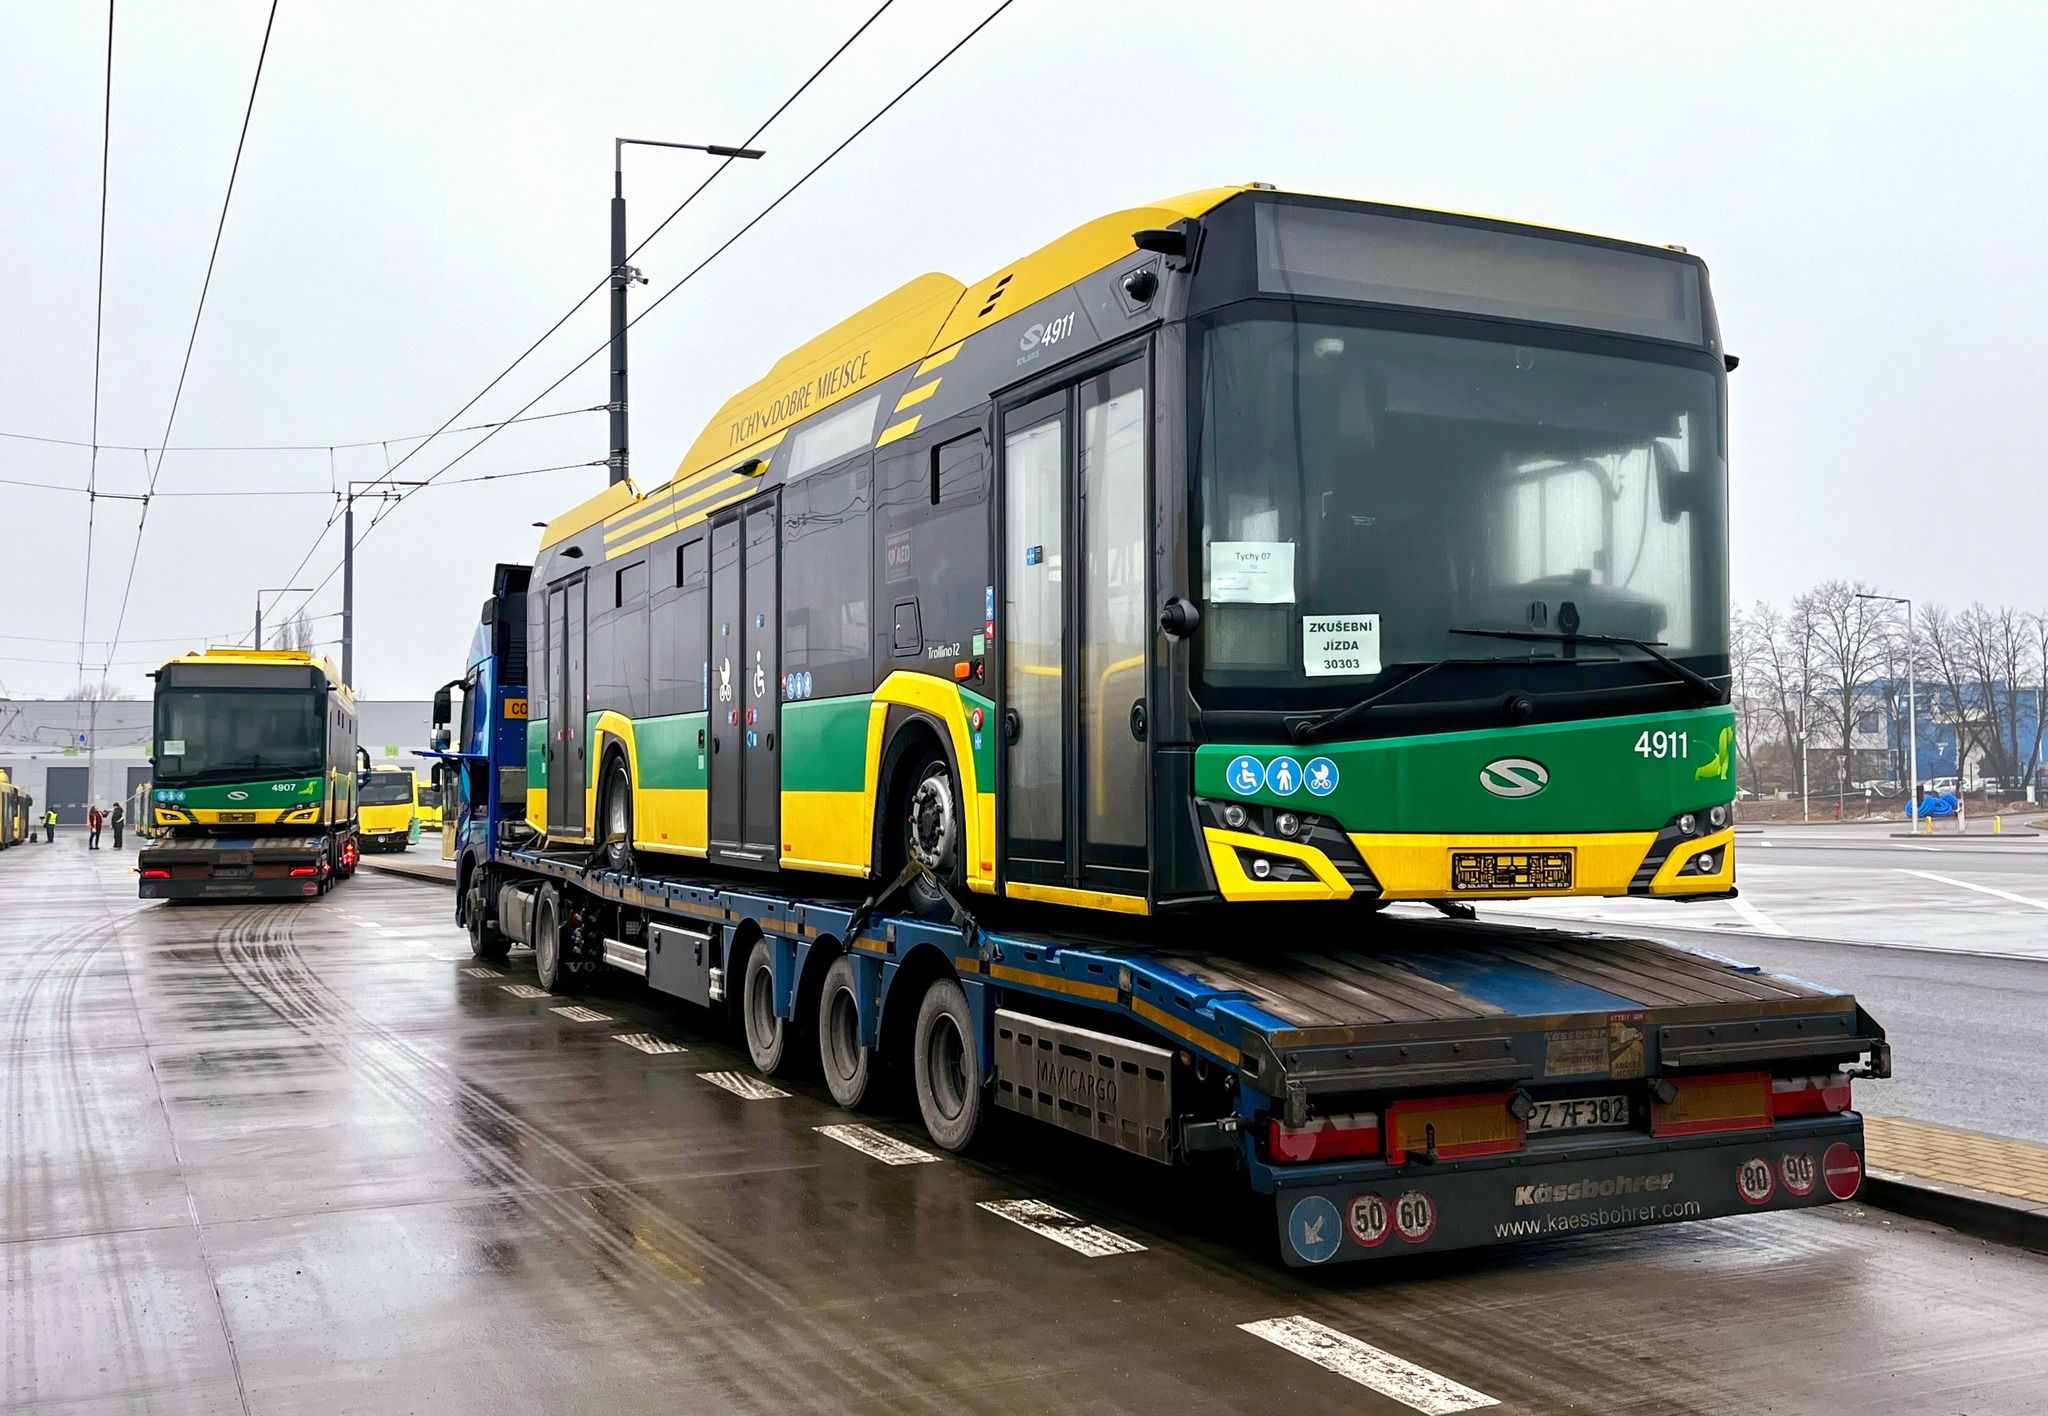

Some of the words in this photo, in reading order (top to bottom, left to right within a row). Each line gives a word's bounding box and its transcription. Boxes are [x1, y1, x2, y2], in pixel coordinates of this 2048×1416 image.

[1041, 311, 1075, 347] 4911
[730, 409, 763, 447] TYCHY
[771, 381, 814, 425] DOBRE
[816, 350, 871, 402] MIEJSCE
[1235, 552, 1259, 561] Tychy
[1261, 552, 1271, 560] 07
[1309, 620, 1372, 633] ZKUŠEBNÍ
[1323, 640, 1359, 651] JÍZDA
[1324, 659, 1360, 669] 30303
[1634, 730, 1687, 758] 4911
[271, 783, 296, 792] 4907
[1037, 1060, 1117, 1103] MAXICARGO
[1744, 1166, 1767, 1191] 80
[1786, 1156, 1810, 1182] 90
[1514, 1173, 1674, 1206] Kässbohrer
[1355, 1201, 1383, 1233] 50
[1401, 1200, 1427, 1229] 60
[1494, 1200, 1700, 1238] www.kaessbohrer.com
